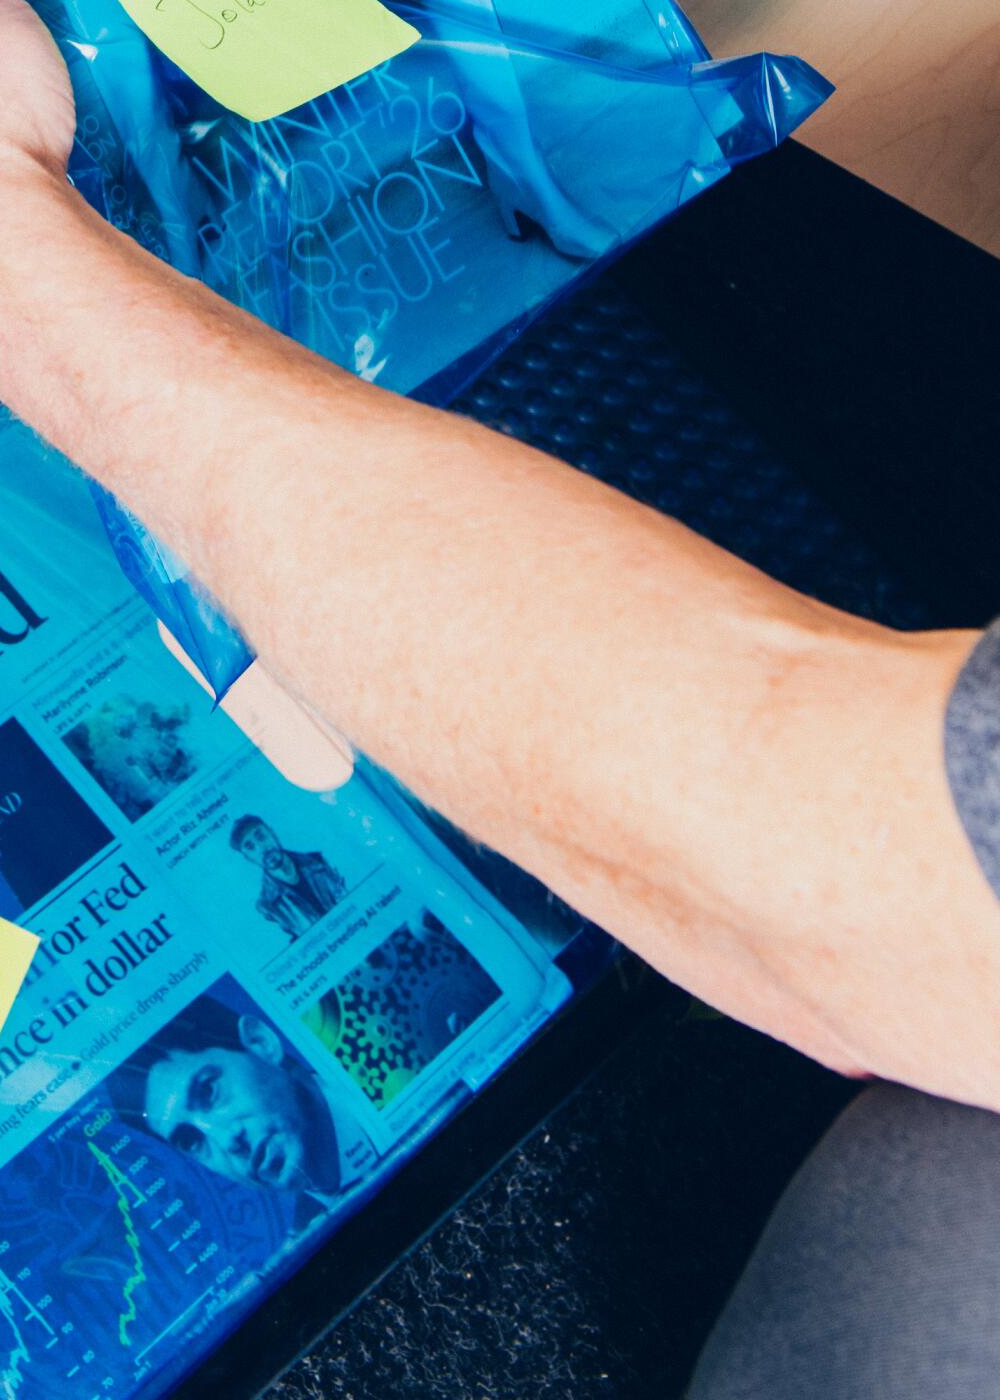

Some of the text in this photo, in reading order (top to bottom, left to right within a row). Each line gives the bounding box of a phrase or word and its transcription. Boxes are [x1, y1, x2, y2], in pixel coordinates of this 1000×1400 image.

[309, 215, 468, 352] ISSUE
[40, 652, 129, 724] Marilynne Robinson
[153, 791, 230, 857] Actor Riz Ahmed
[77, 857, 148, 930] Fed
[275, 975, 301, 999] The
[293, 946, 331, 984] schools
[324, 912, 372, 957] breeding
[373, 881, 405, 915] talent
[41, 977, 90, 1032] in
[75, 905, 177, 1001] dollar
[14, 1086, 48, 1122] fears
[41, 1064, 73, 1096] ease
[75, 1028, 111, 1064] Gold
[106, 1008, 139, 1044] price
[134, 980, 173, 1017] drops
[165, 945, 212, 989] sharply
[81, 1108, 114, 1139] Gold
